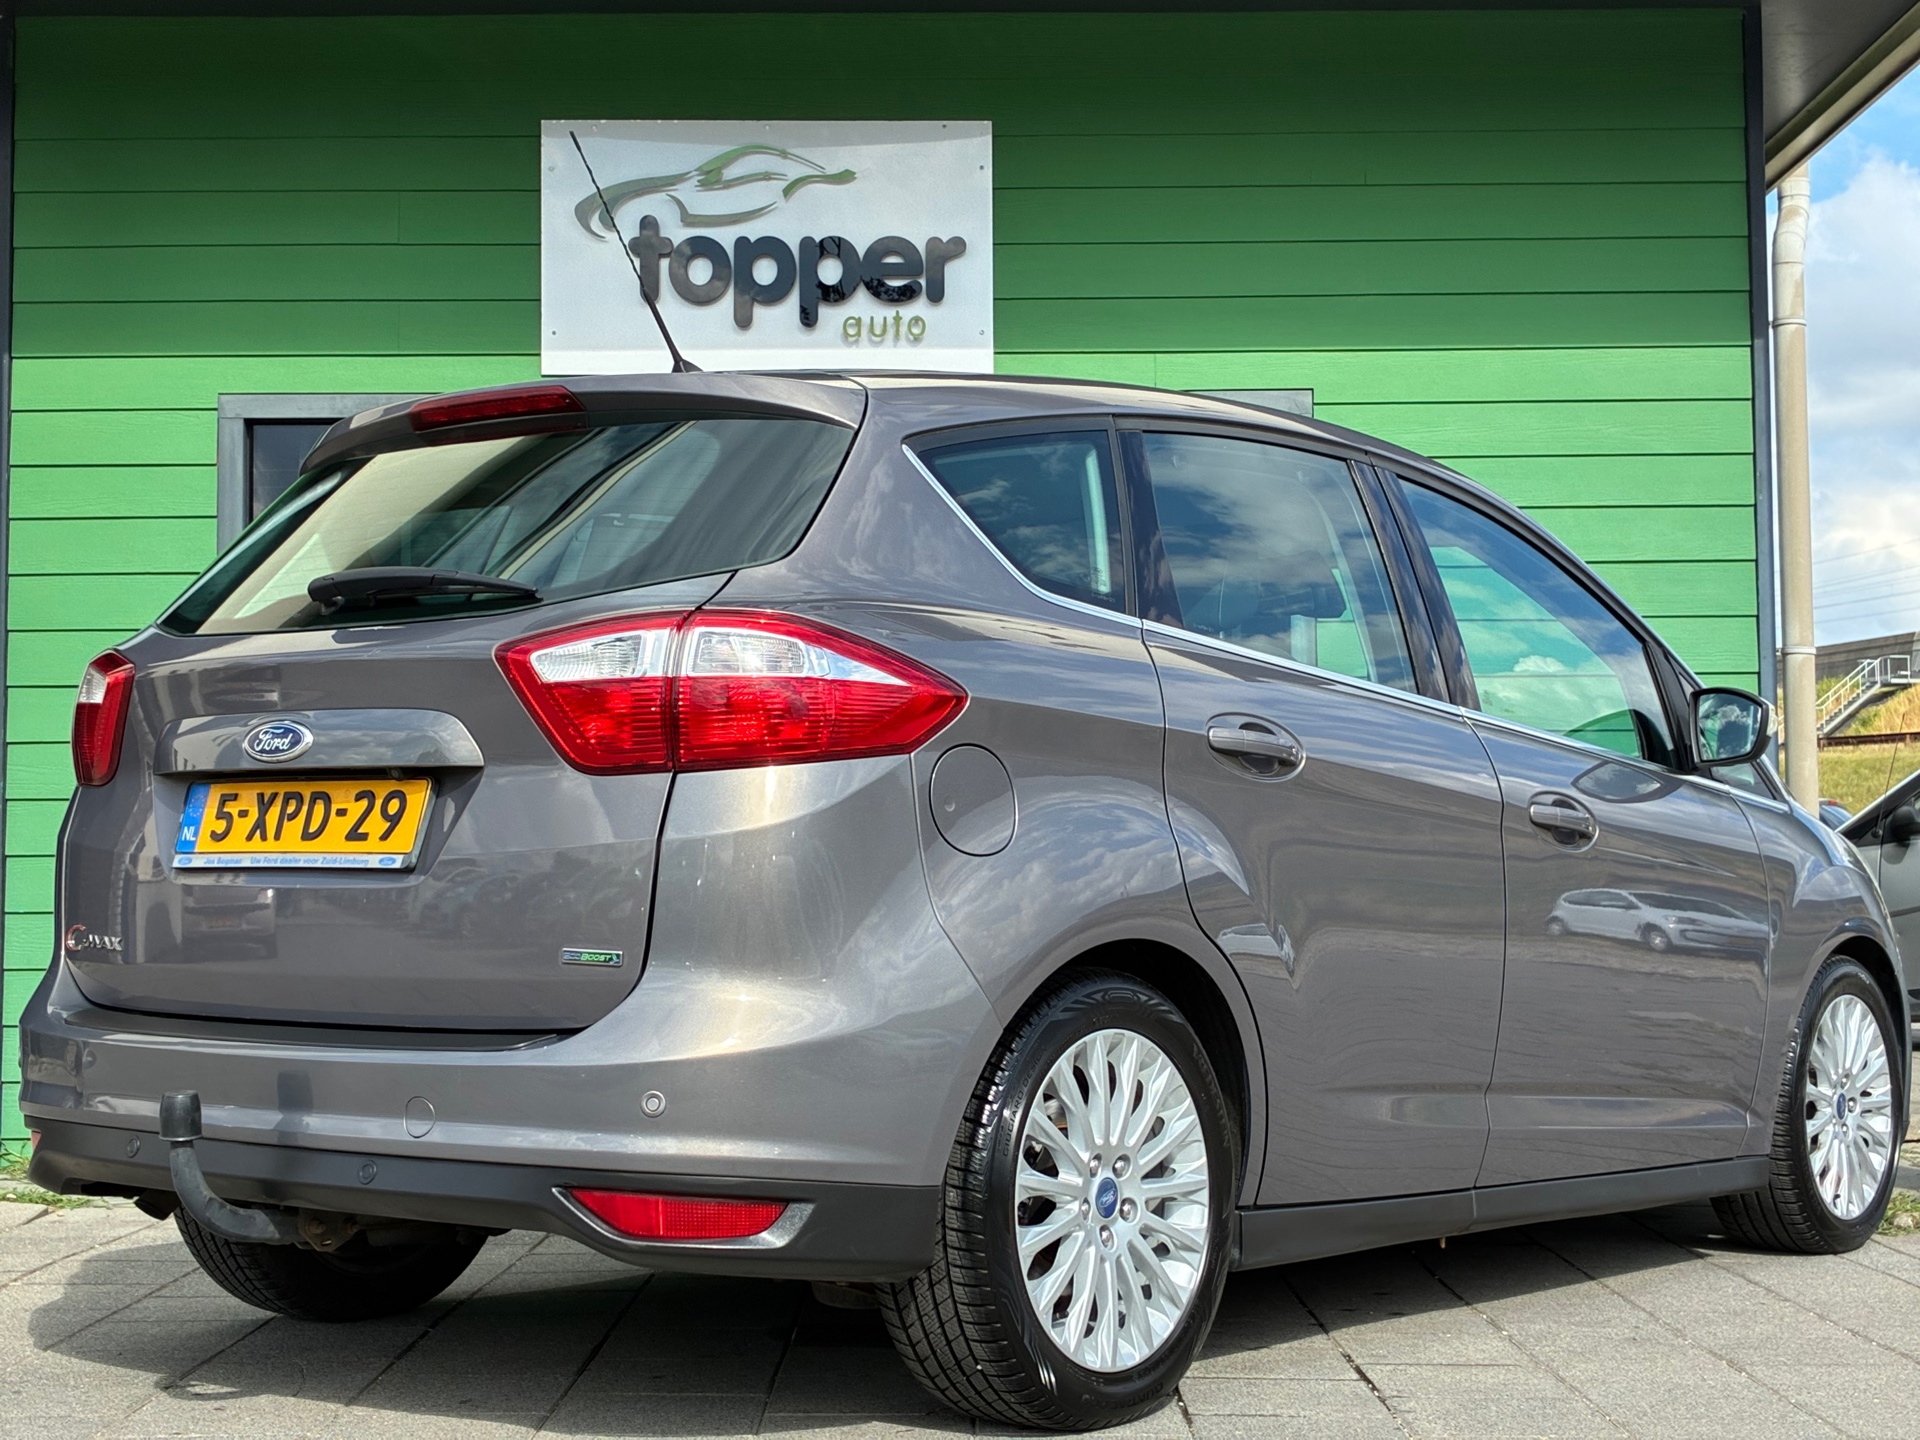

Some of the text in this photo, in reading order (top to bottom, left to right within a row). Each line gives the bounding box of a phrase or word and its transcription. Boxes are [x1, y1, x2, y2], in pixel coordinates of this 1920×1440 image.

[627, 214, 967, 329] topper
[842, 310, 927, 339] auto
[254, 728, 293, 751] Ford
[209, 789, 408, 843] 5-XPD-29
[182, 826, 197, 841] NL
